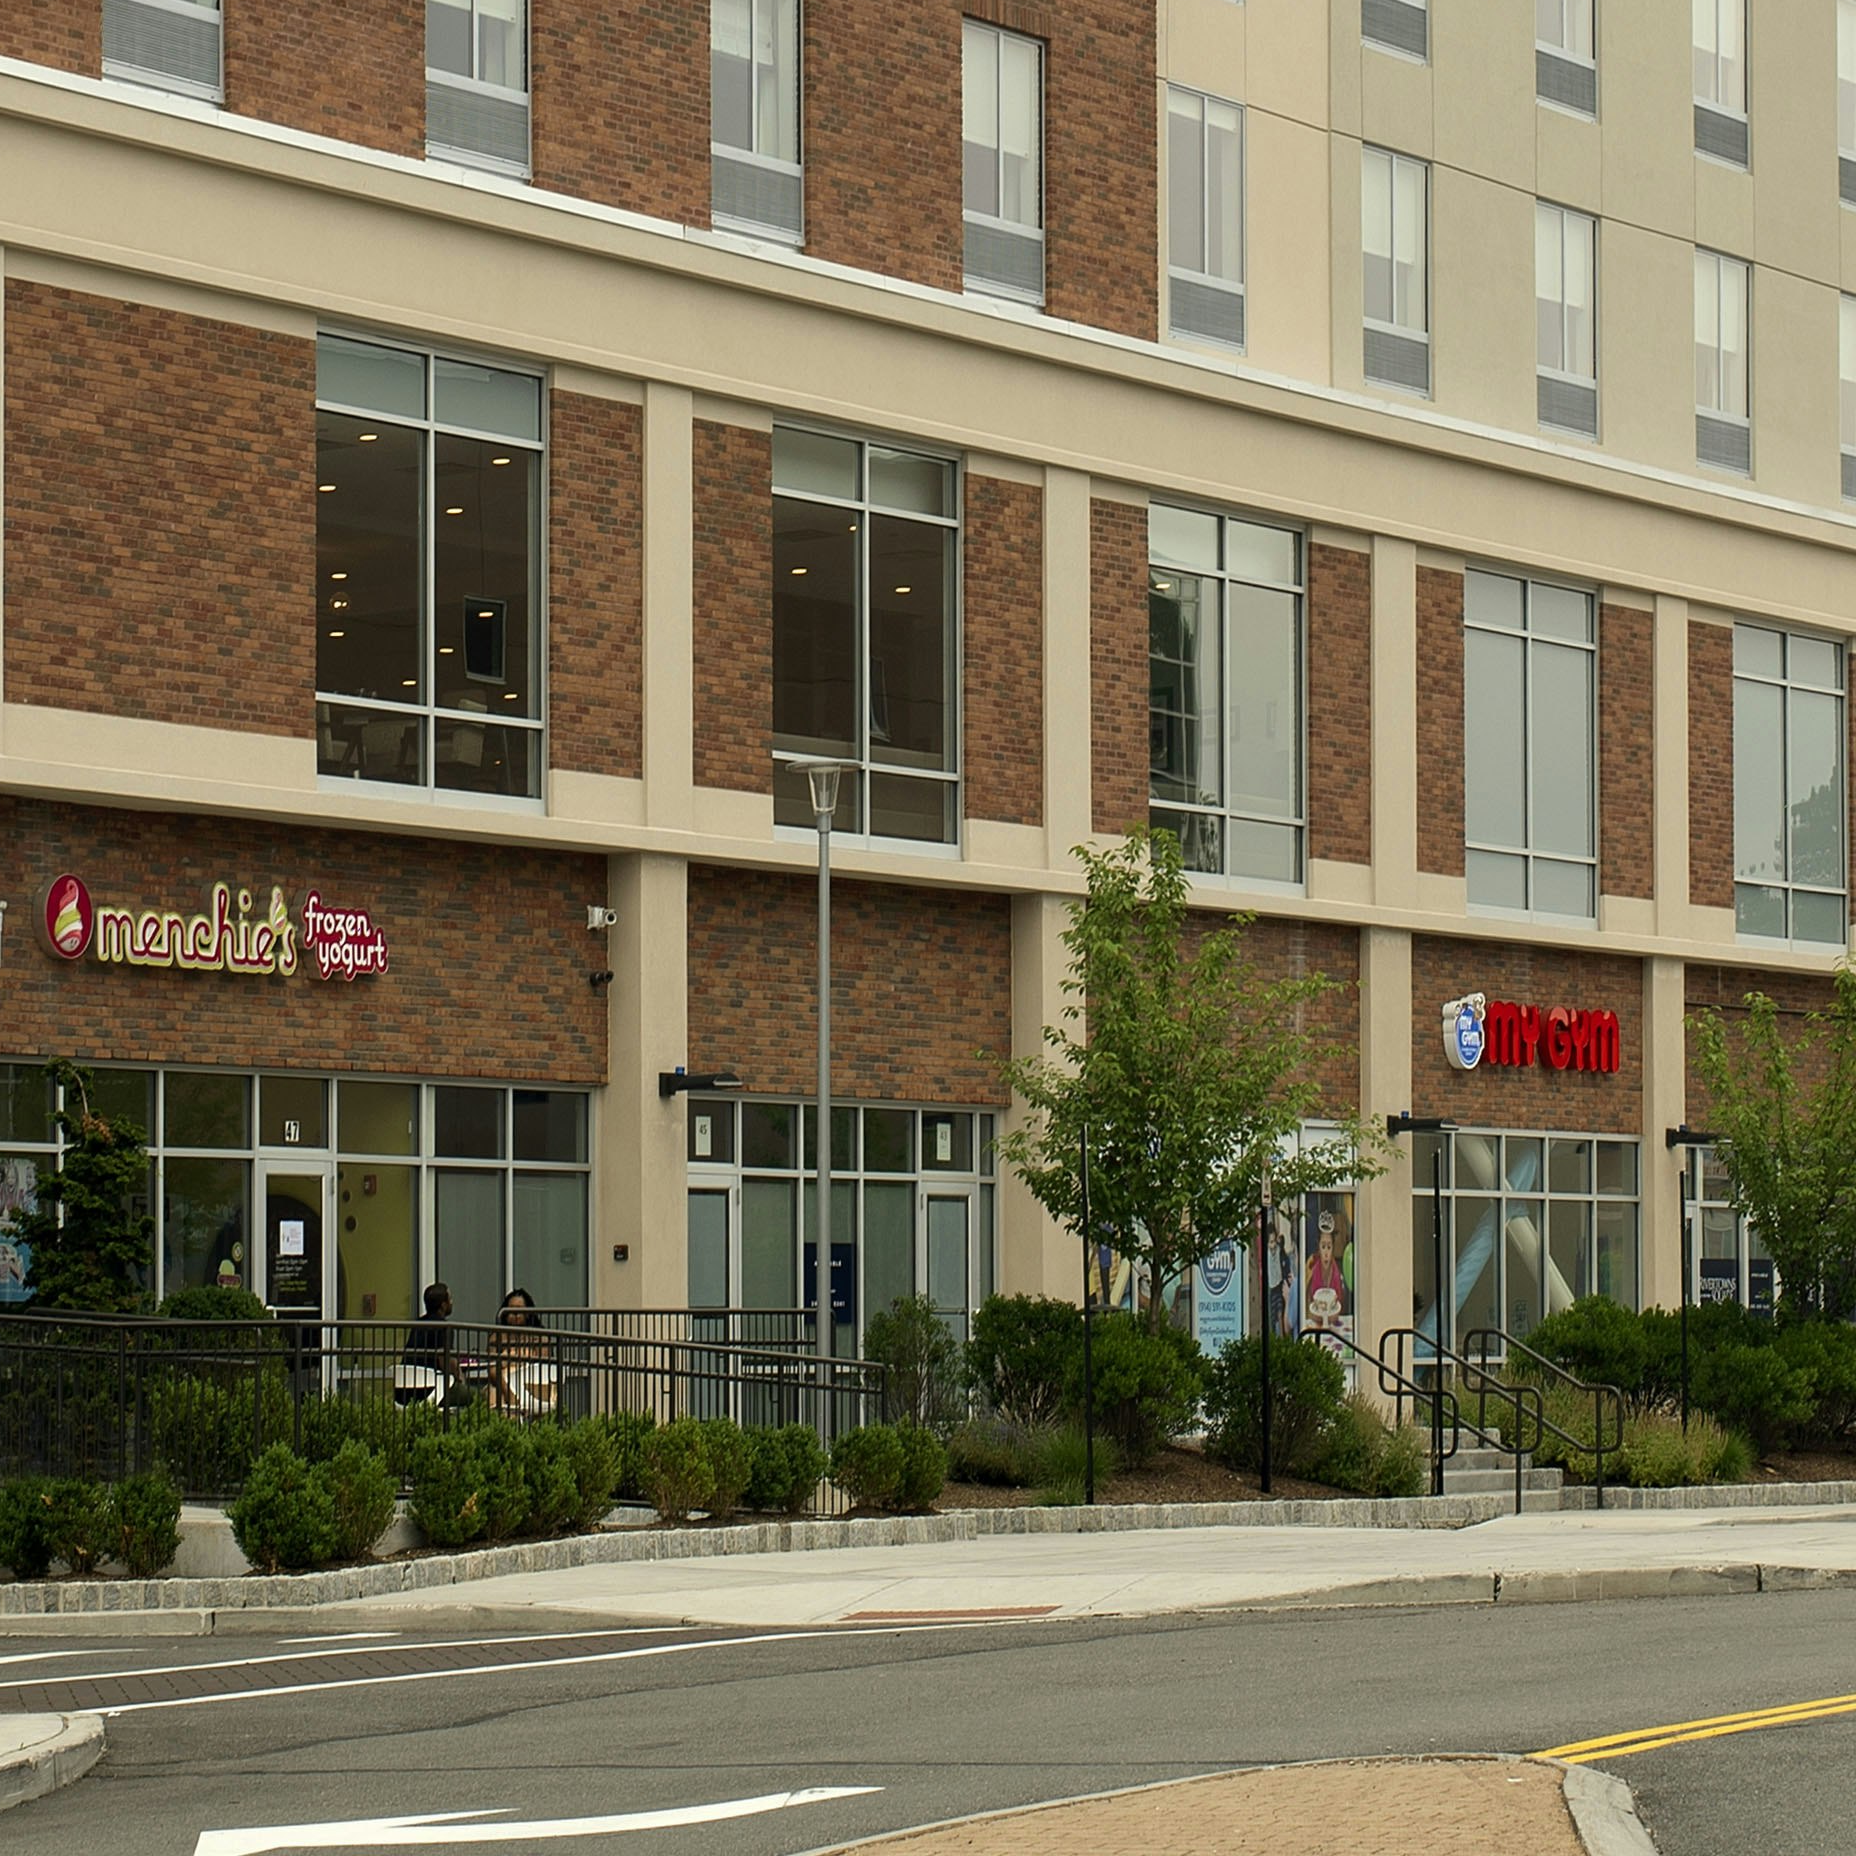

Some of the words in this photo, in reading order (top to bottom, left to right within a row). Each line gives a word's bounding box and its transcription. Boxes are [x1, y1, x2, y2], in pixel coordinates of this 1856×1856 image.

[97, 881, 298, 977] menchie's
[304, 895, 371, 947] frozen
[318, 931, 386, 975] yogurt
[286, 1122, 298, 1140] 47
